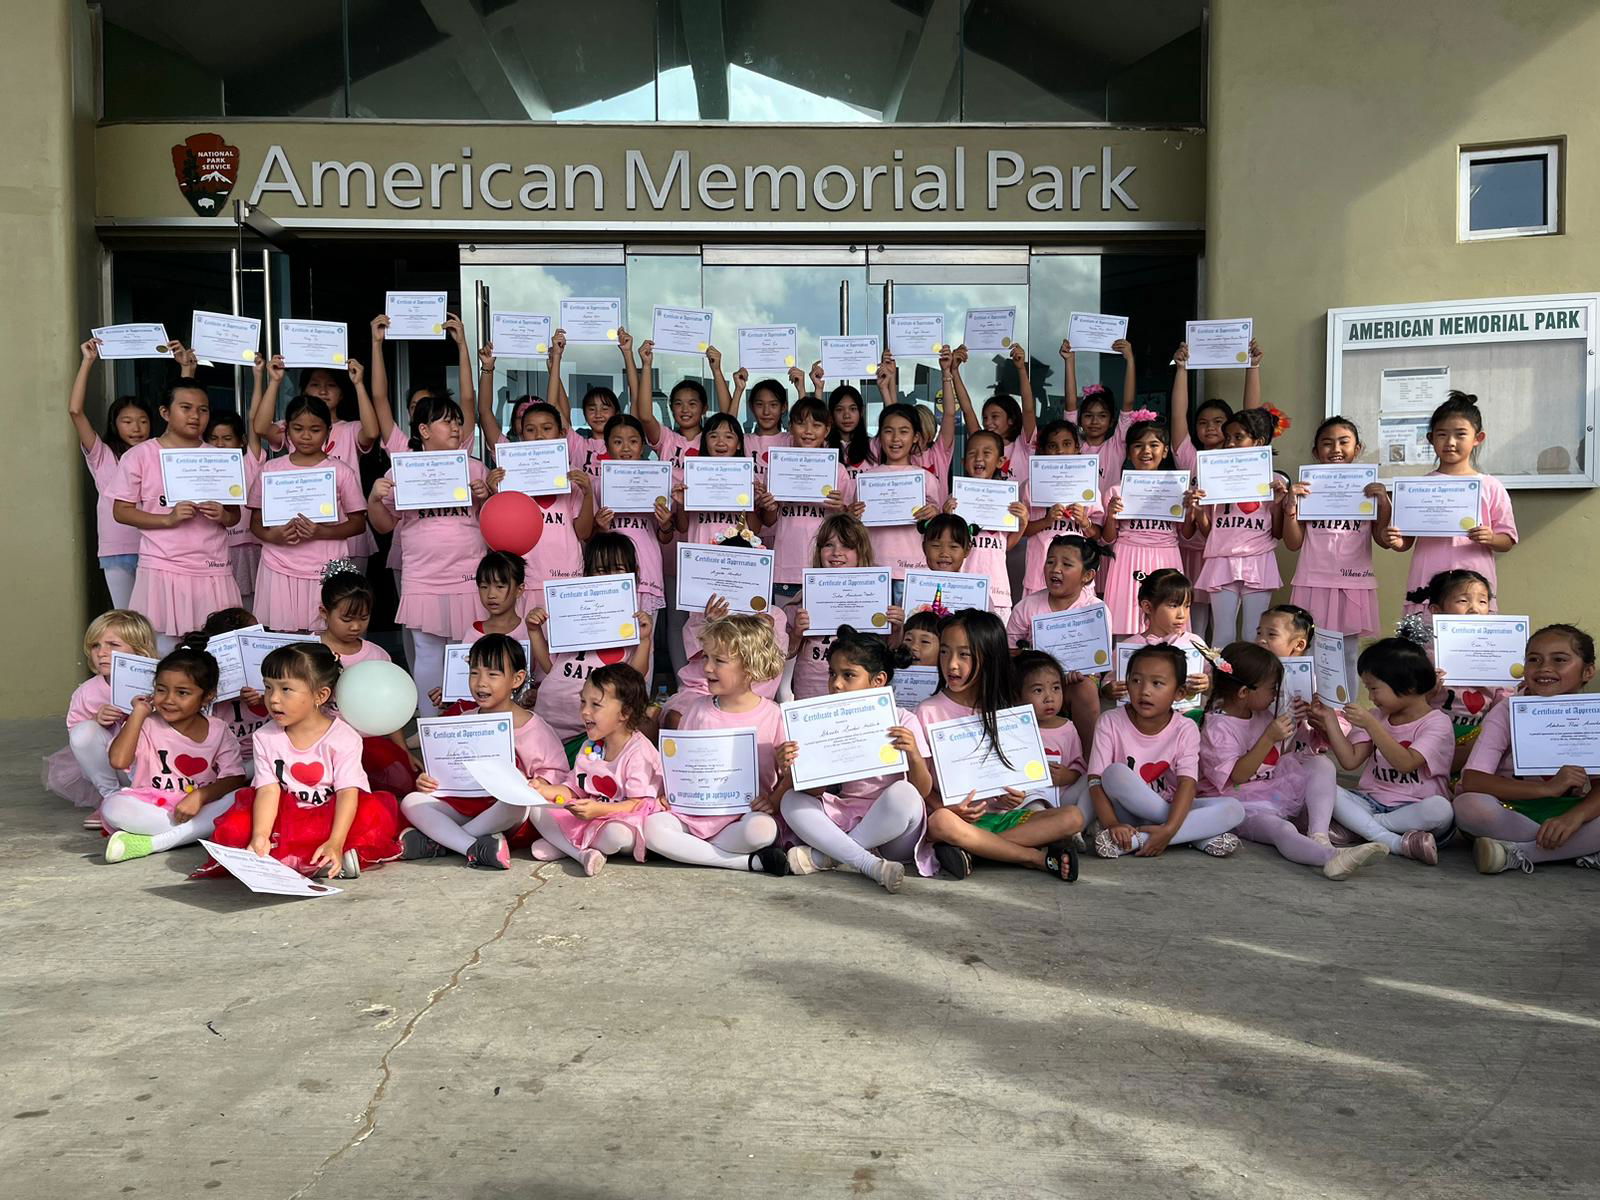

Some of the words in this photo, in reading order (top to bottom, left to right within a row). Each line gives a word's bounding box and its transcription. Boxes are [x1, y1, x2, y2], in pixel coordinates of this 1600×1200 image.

[247, 145, 605, 210] American
[624, 146, 965, 211] Memorial
[986, 146, 1140, 211] Park
[1349, 318, 1434, 340] AMERICAN
[1440, 314, 1529, 336] MEMORIAL
[1534, 310, 1581, 330] PARK
[550, 570, 570, 578] Where
[1340, 568, 1361, 578] Where
[818, 579, 842, 587] Certificate
[558, 590, 583, 600] Certificate
[1450, 626, 1476, 634] Certificate
[1482, 626, 1513, 636] Appreciation
[1442, 689, 1455, 710] I
[803, 711, 832, 722] Certificate
[840, 704, 876, 716] Appreciation
[1532, 708, 1564, 716] Certificate
[433, 730, 456, 739] Certificate
[462, 730, 495, 738] Appreciation
[158, 750, 172, 774] I
